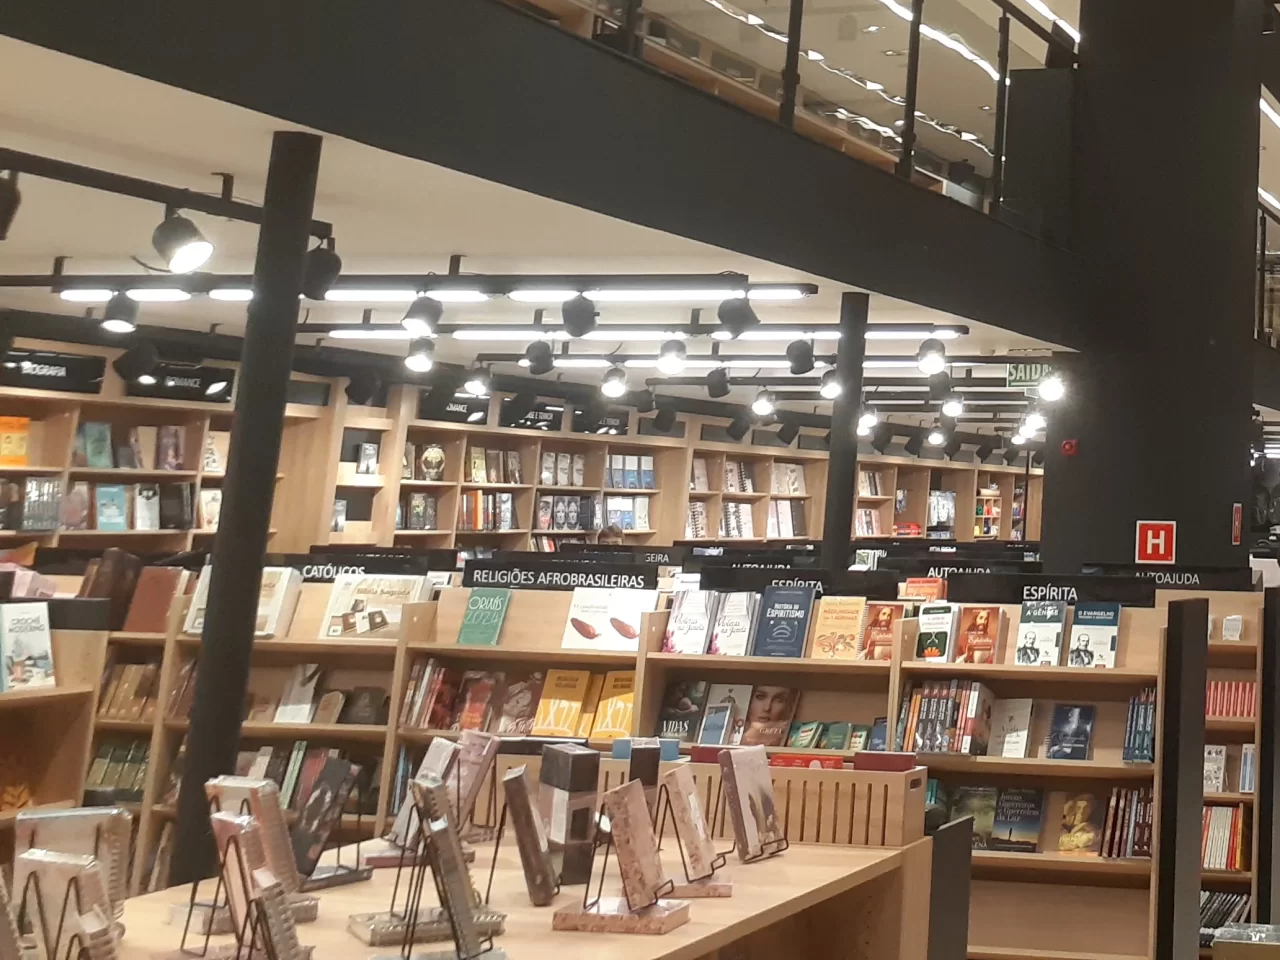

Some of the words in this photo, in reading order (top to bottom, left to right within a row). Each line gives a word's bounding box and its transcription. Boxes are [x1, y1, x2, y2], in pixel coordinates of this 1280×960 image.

[165, 376, 201, 388] ROMANCE
[1146, 530, 1165, 554] H
[302, 563, 366, 578] CATÓLICOS
[473, 568, 535, 584] RELIGIÕES
[537, 571, 645, 588] AFROBRASILEIRAS
[1023, 583, 1078, 601] ESPÍRITA
[766, 609, 805, 619] ESPIRITISMO
[662, 720, 690, 733] VIDAS
